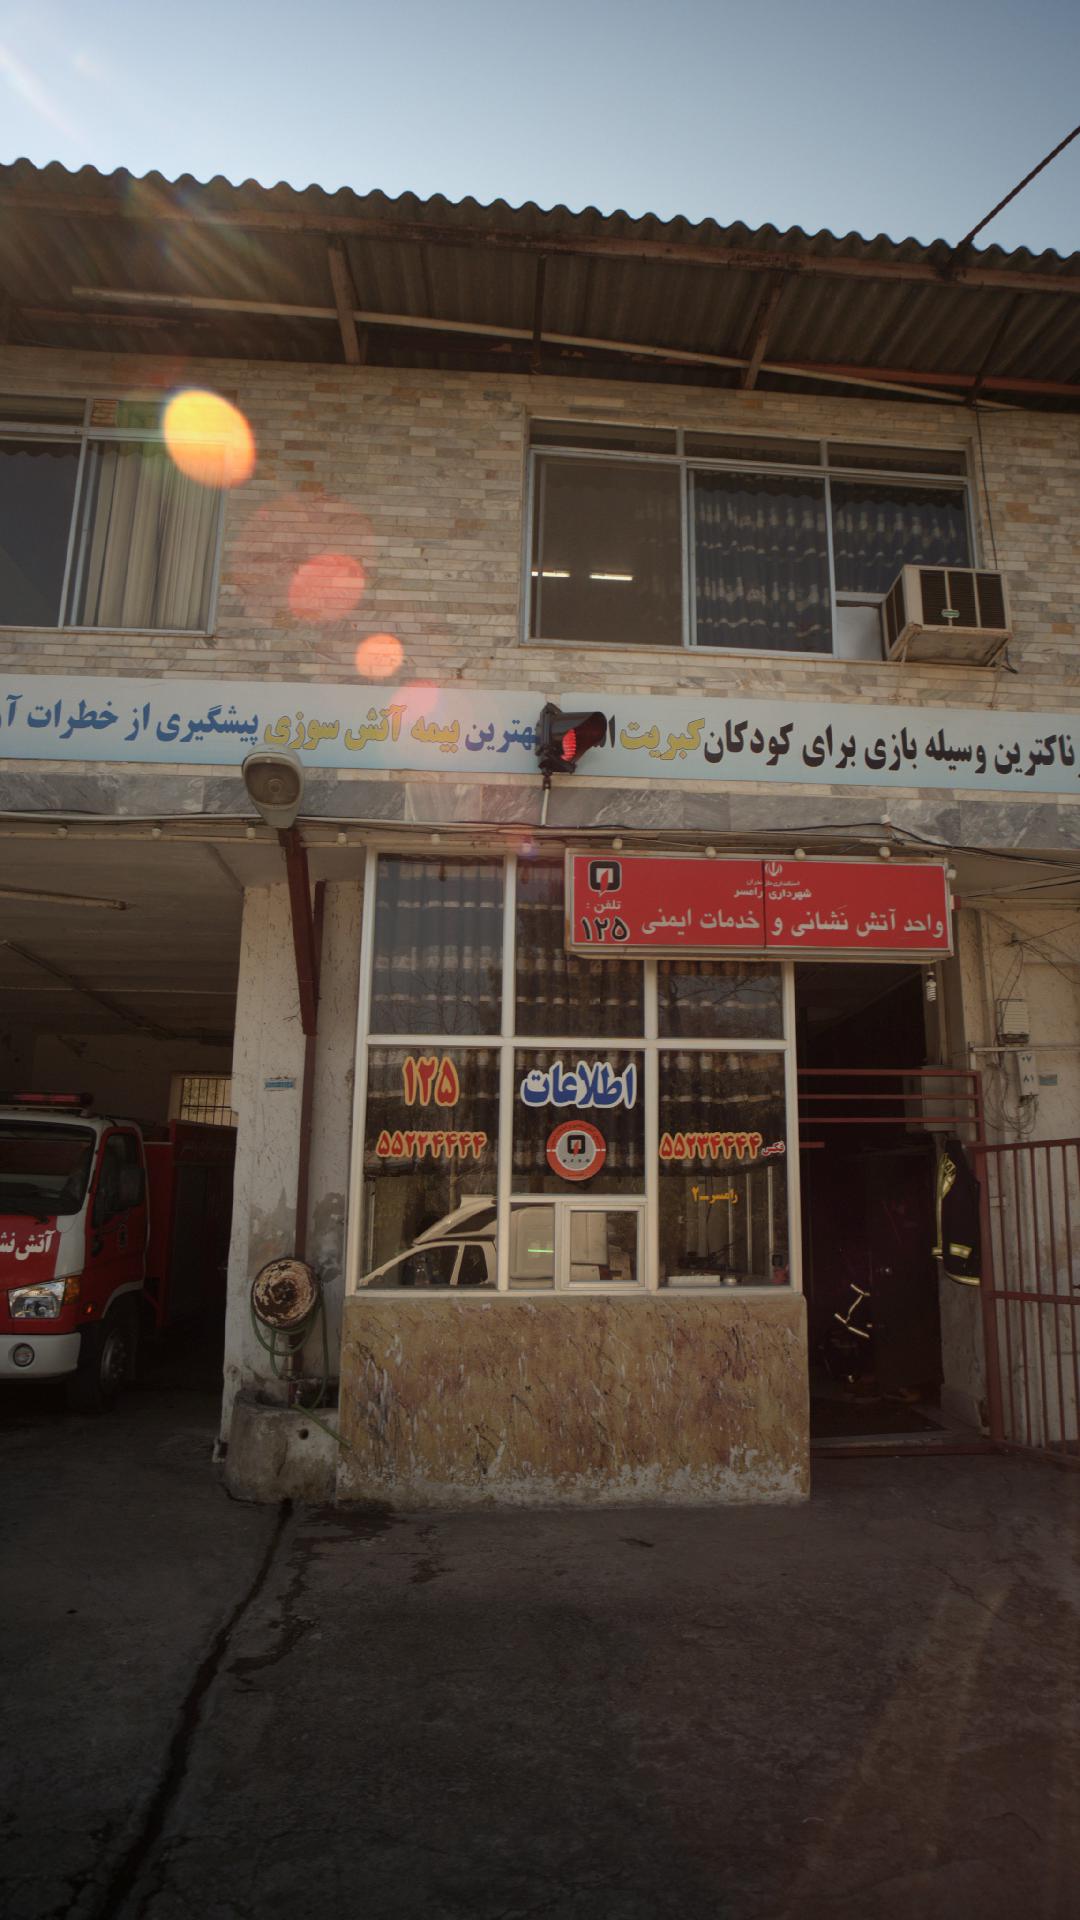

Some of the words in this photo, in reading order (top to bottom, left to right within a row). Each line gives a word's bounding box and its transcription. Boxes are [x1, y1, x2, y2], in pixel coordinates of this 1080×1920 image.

[27, 700, 119, 740] خطرات
[125, 702, 150, 741] از
[157, 705, 259, 745] پیشگیری
[263, 713, 340, 750] سوزی
[345, 704, 408, 751] آتش
[411, 717, 461, 754] بیمه
[620, 718, 705, 761] کبریت
[704, 720, 794, 765] کودکان
[802, 725, 856, 769] برای
[864, 727, 918, 771] بازی
[925, 729, 987, 774] وسیله
[995, 734, 1080, 778] ناکترین
[733, 887, 764, 899] رامسر
[581, 915, 631, 942] ۱۲۵
[641, 907, 692, 937] ایمنی
[700, 909, 760, 931] خدمات
[772, 916, 784, 936] و
[790, 905, 849, 937] نشانی
[856, 908, 897, 937] آتش
[903, 913, 944, 938] واحد
[403, 1056, 459, 1107] ۱۲۵
[520, 1060, 637, 1109] اطلاعات
[15, 1229, 56, 1261] آتش
